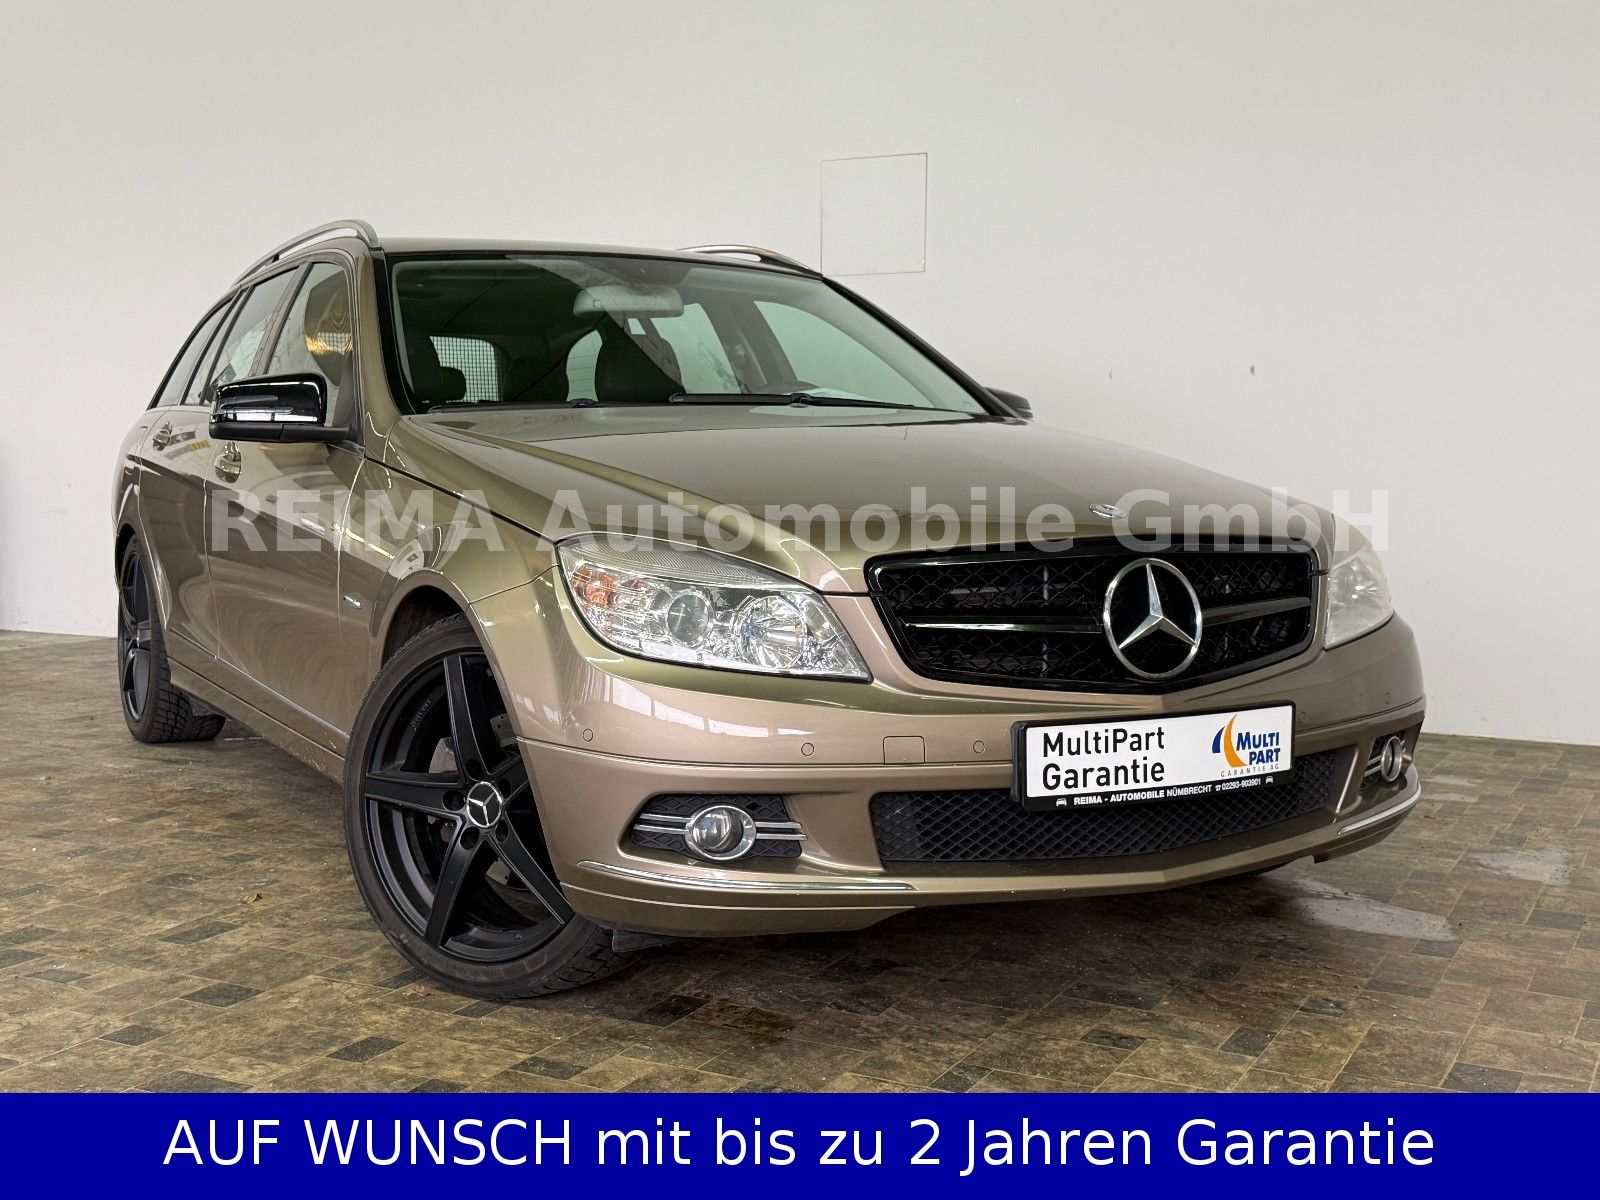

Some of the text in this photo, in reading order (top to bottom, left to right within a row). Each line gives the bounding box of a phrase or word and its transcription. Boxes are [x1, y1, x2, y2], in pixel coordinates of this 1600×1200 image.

[1043, 727, 1165, 757] MultiPart
[1249, 748, 1281, 765] PART
[1042, 757, 1165, 790] Garantie
[1220, 763, 1279, 777] GARANTIE AG
[1073, 796, 1103, 806] REIMA
[1110, 790, 1165, 803] AUTOMOBILE
[1166, 784, 1212, 797] NÜMBRECHT
